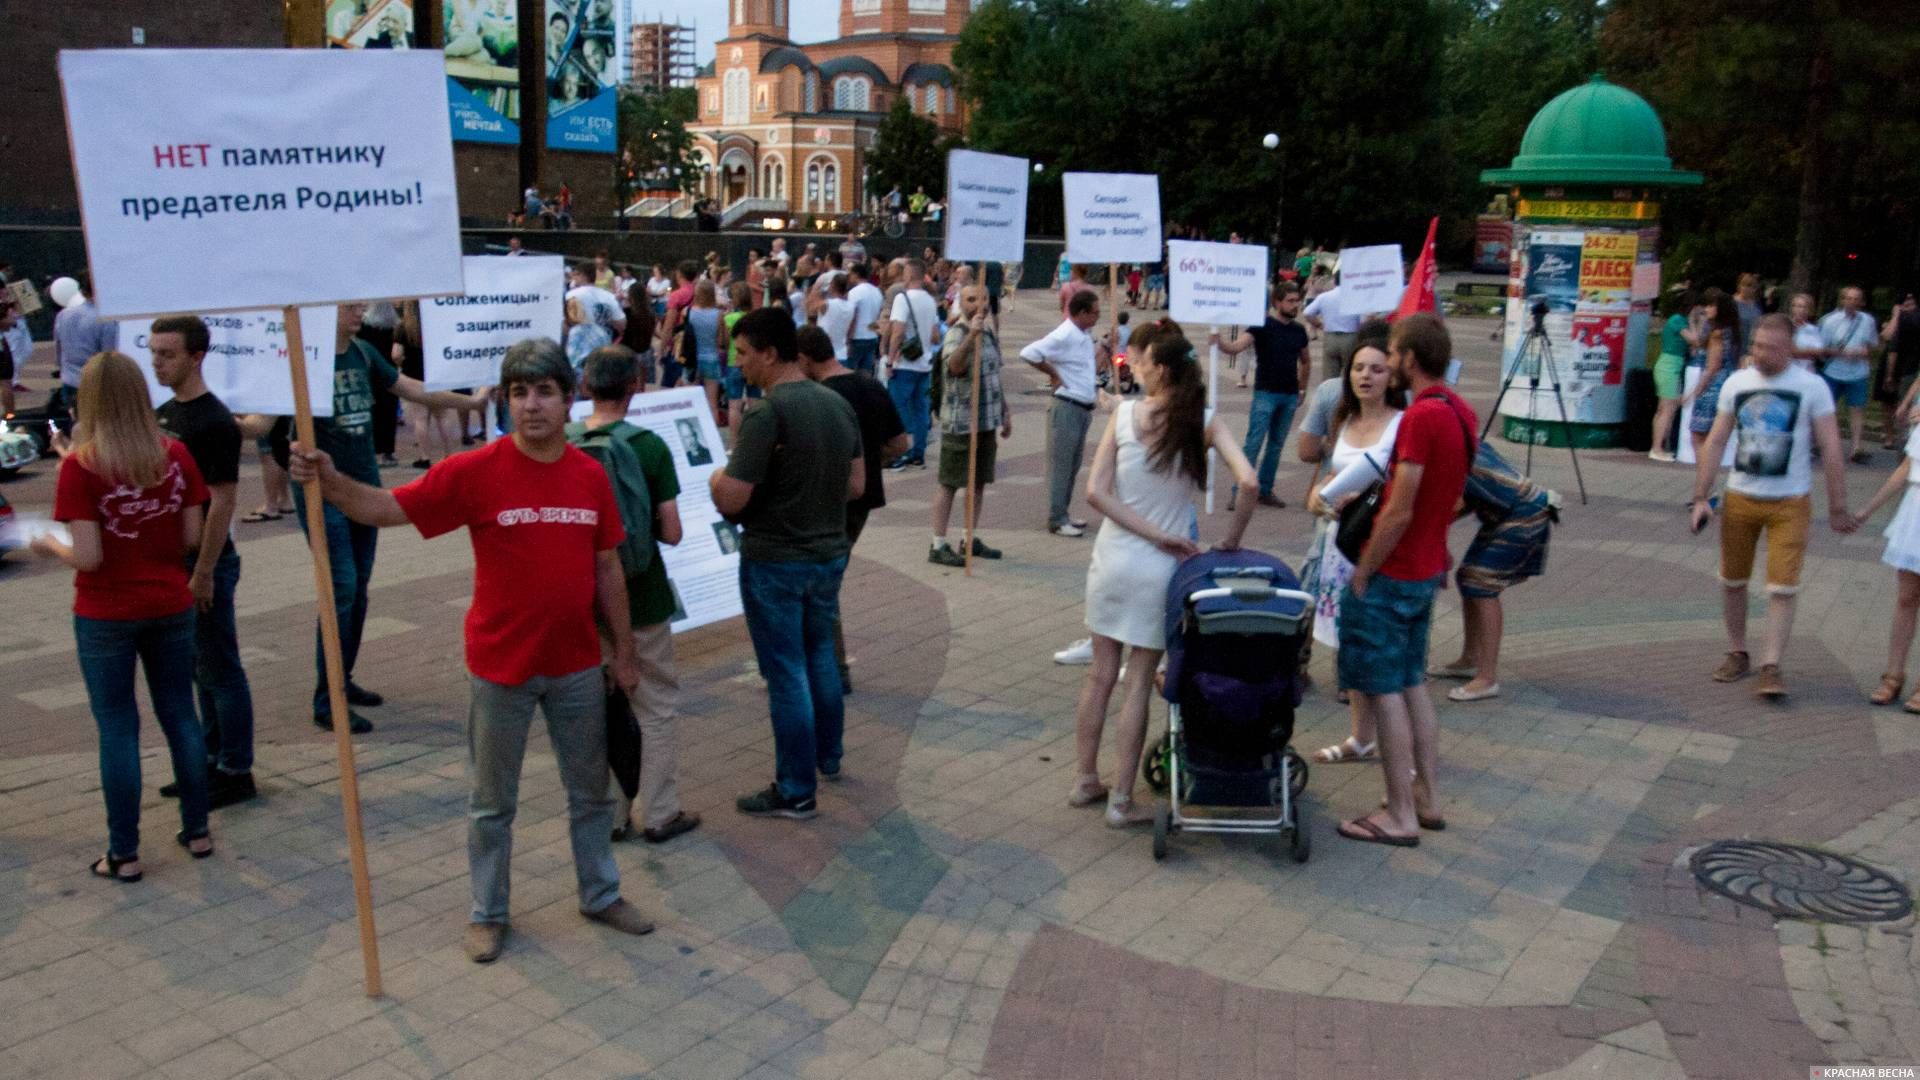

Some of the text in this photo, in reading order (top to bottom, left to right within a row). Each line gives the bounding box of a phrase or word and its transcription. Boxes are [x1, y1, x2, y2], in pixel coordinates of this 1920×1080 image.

[153, 144, 385, 169] НЕТ памятнику
[122, 182, 423, 221] предателя Родины!
[1094, 194, 1128, 204] Сегодня
[1583, 236, 1618, 248] 24-27
[1179, 257, 1214, 274] 66%
[1583, 260, 1633, 277] БЛЕСК
[456, 319, 533, 334] защитник
[498, 508, 540, 526] СУТЬ
